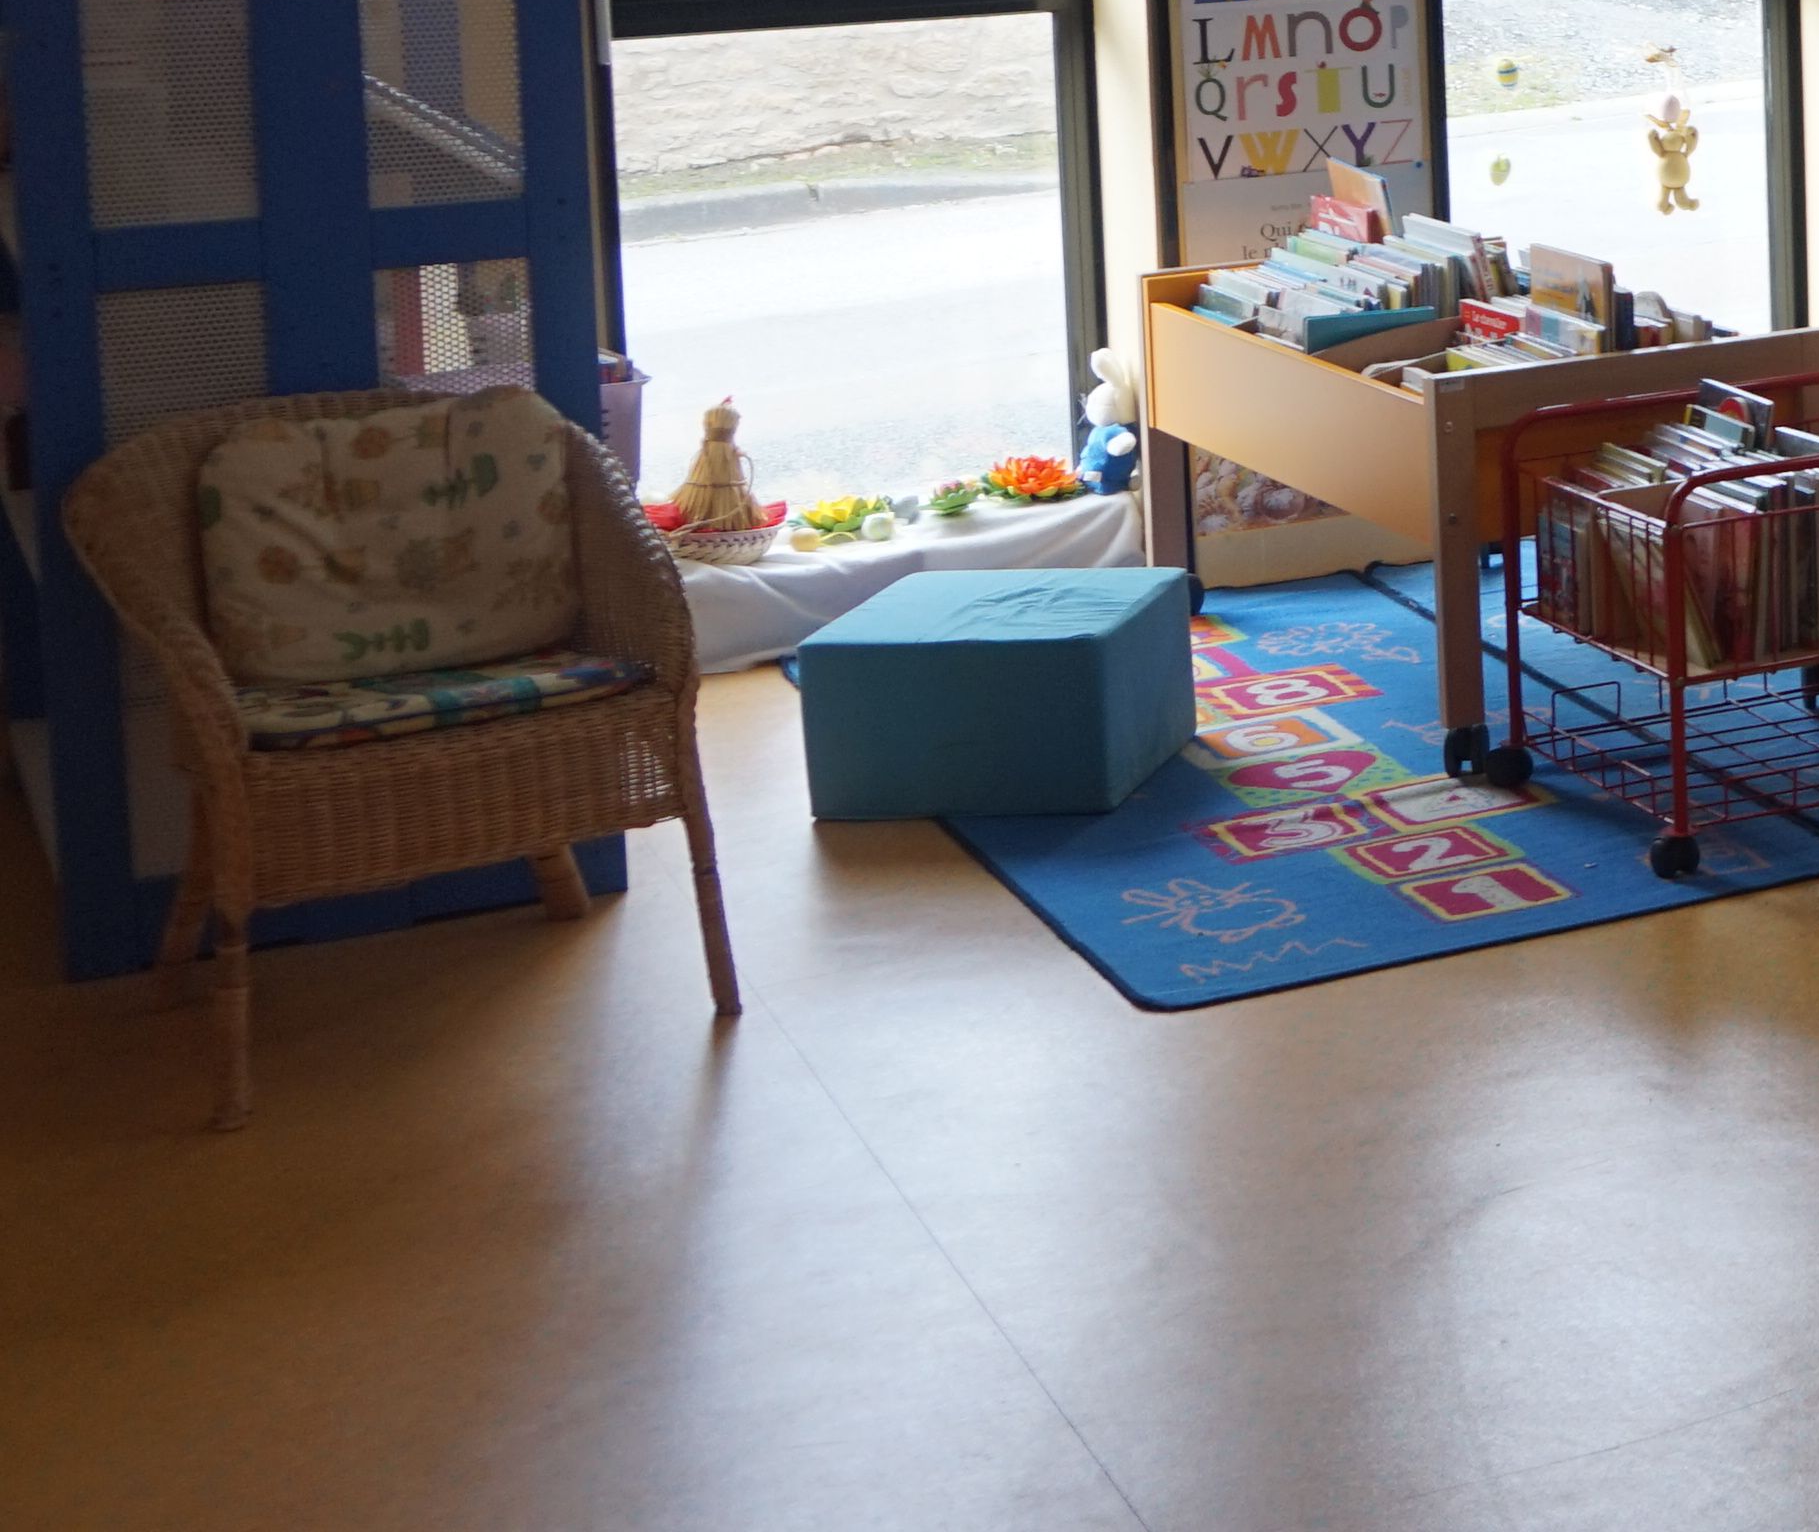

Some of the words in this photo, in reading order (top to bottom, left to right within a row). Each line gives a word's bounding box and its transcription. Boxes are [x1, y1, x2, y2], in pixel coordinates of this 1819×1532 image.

[1260, 221, 1292, 242] Qui
[1245, 678, 1331, 706] 8
[1225, 724, 1301, 754] 6
[1273, 758, 1354, 789] 5
[1392, 836, 1478, 872] 2
